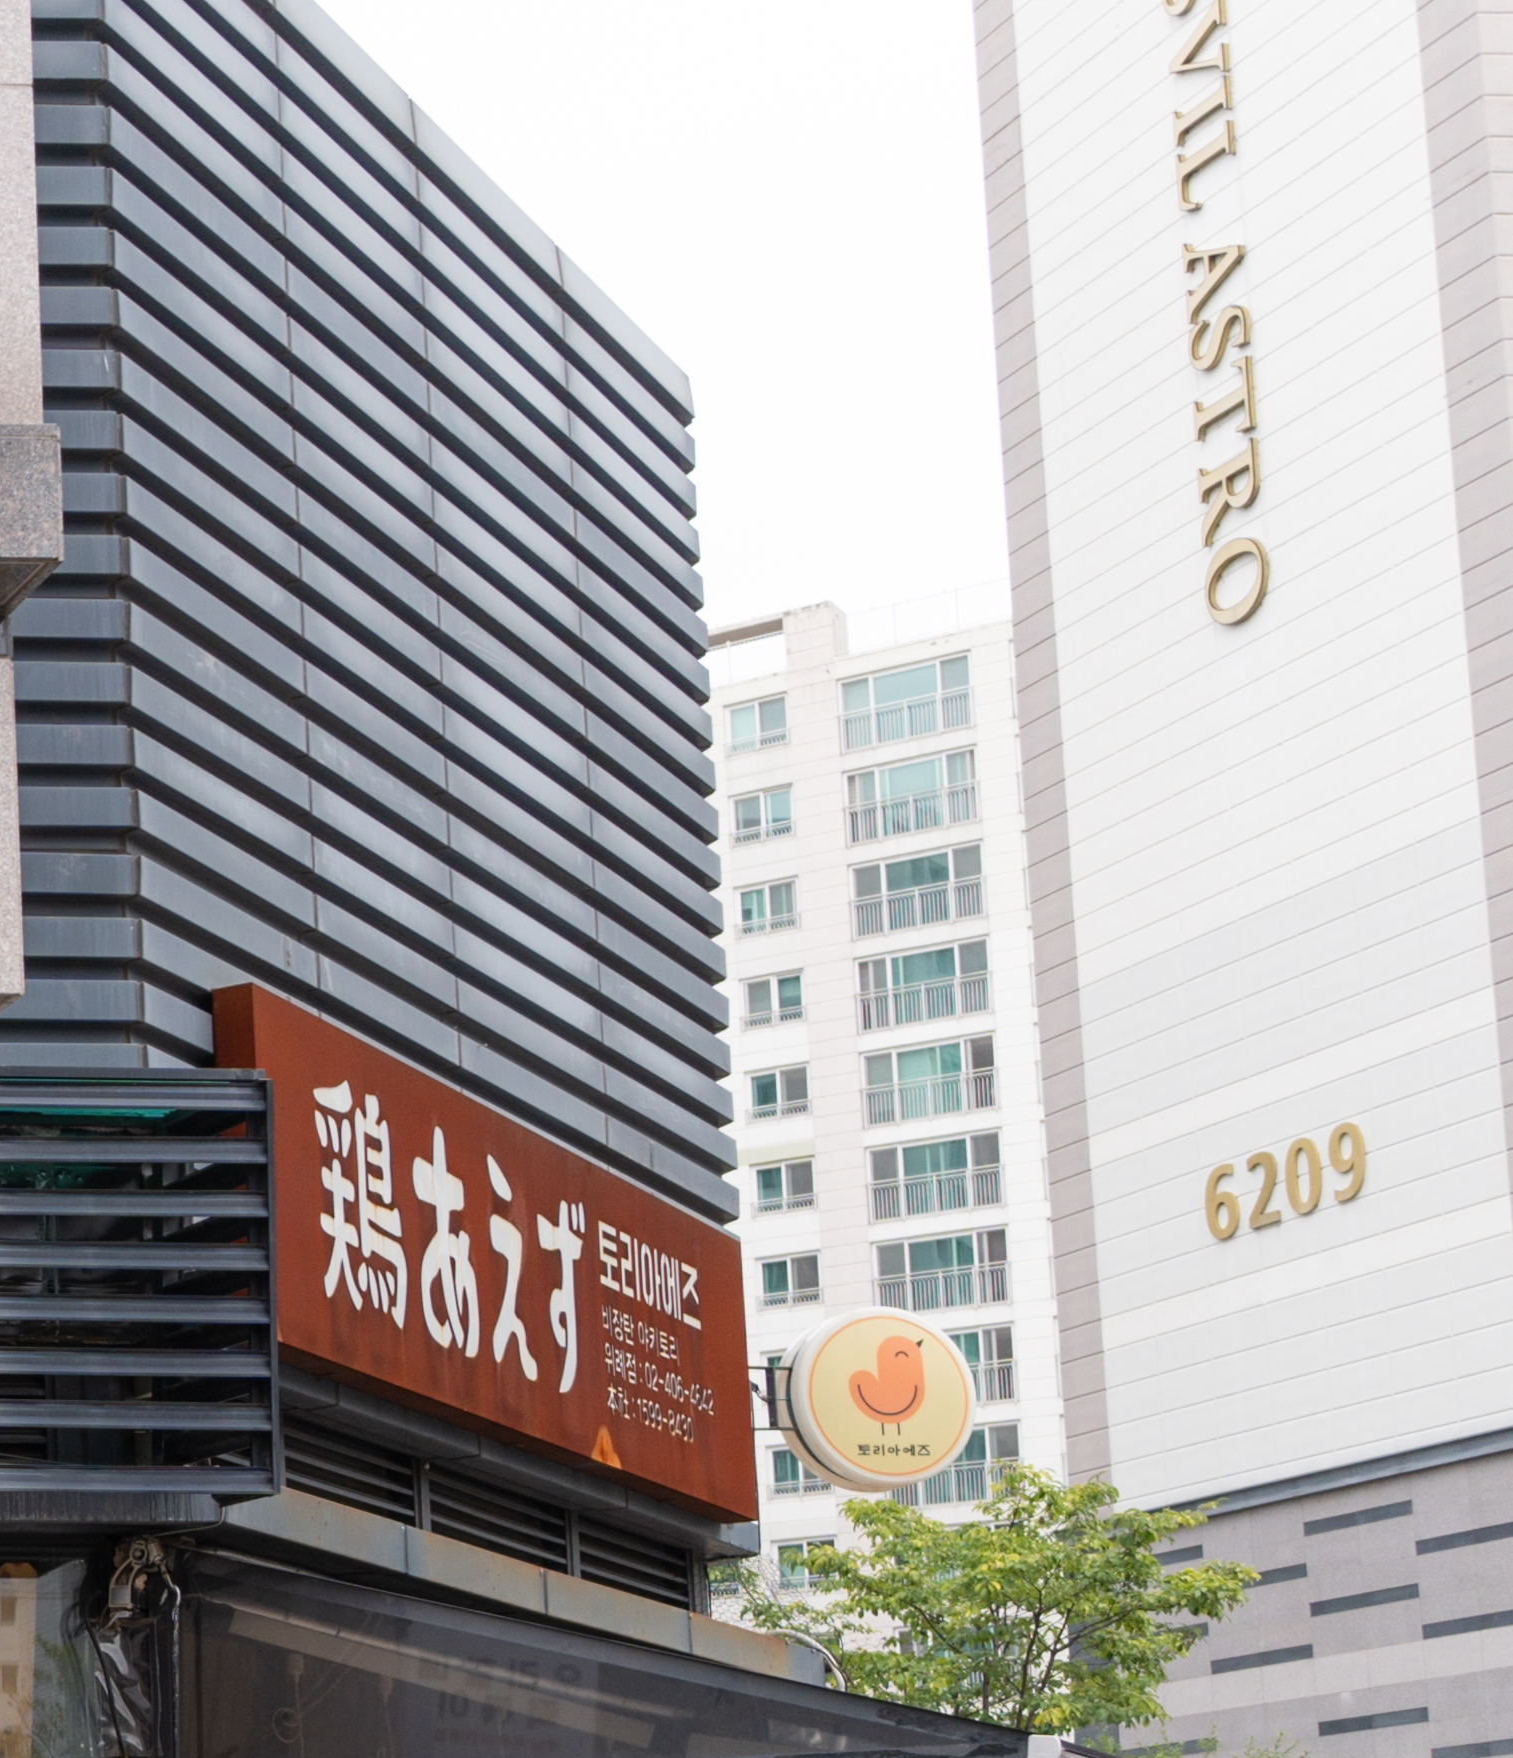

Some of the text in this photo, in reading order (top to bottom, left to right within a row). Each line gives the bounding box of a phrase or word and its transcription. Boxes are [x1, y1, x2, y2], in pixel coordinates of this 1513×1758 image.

[1182, 243, 1270, 628] ASTRO
[1205, 1121, 1367, 1241] 6209
[312, 1080, 587, 1395] 鶏あえず
[598, 1220, 703, 1331] 토리아에즈
[601, 1304, 635, 1346] 비장탄
[604, 1342, 637, 1385] 위례점
[857, 1444, 931, 1456] 토리아에즈
